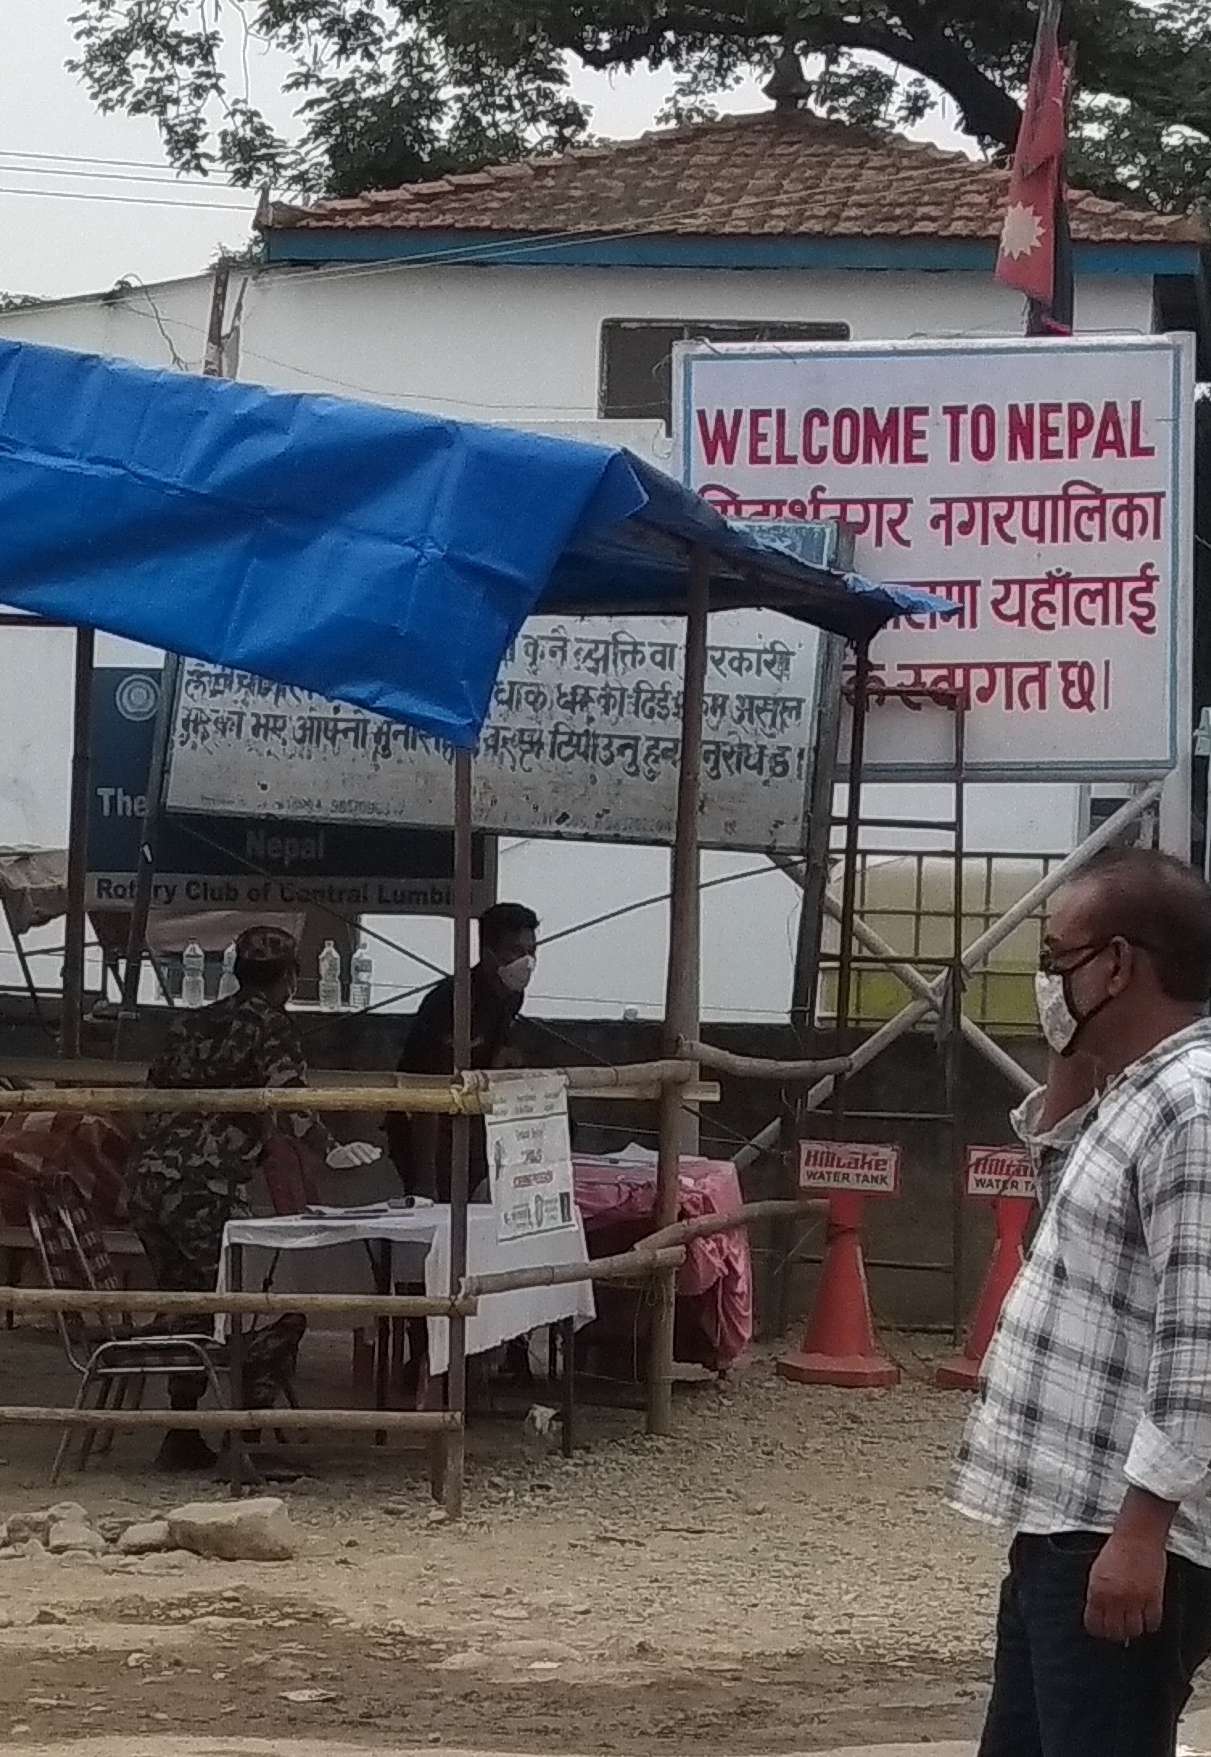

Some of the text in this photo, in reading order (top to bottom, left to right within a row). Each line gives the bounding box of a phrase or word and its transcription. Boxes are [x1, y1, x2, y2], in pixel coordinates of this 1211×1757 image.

[696, 400, 1156, 465] WELCOME TO NEPAL
[929, 480, 1167, 548] नगरपालिका
[991, 562, 1161, 635] यहाँलाई
[707, 640, 797, 683] रकारी
[96, 787, 149, 819] The
[244, 831, 326, 867] Nepal
[97, 878, 178, 904] Rotry
[185, 879, 240, 901] Club
[246, 881, 271, 902] of
[279, 882, 369, 905] Central
[806, 1171, 889, 1186] WATER TANK
[974, 1177, 1019, 1190] WATER
